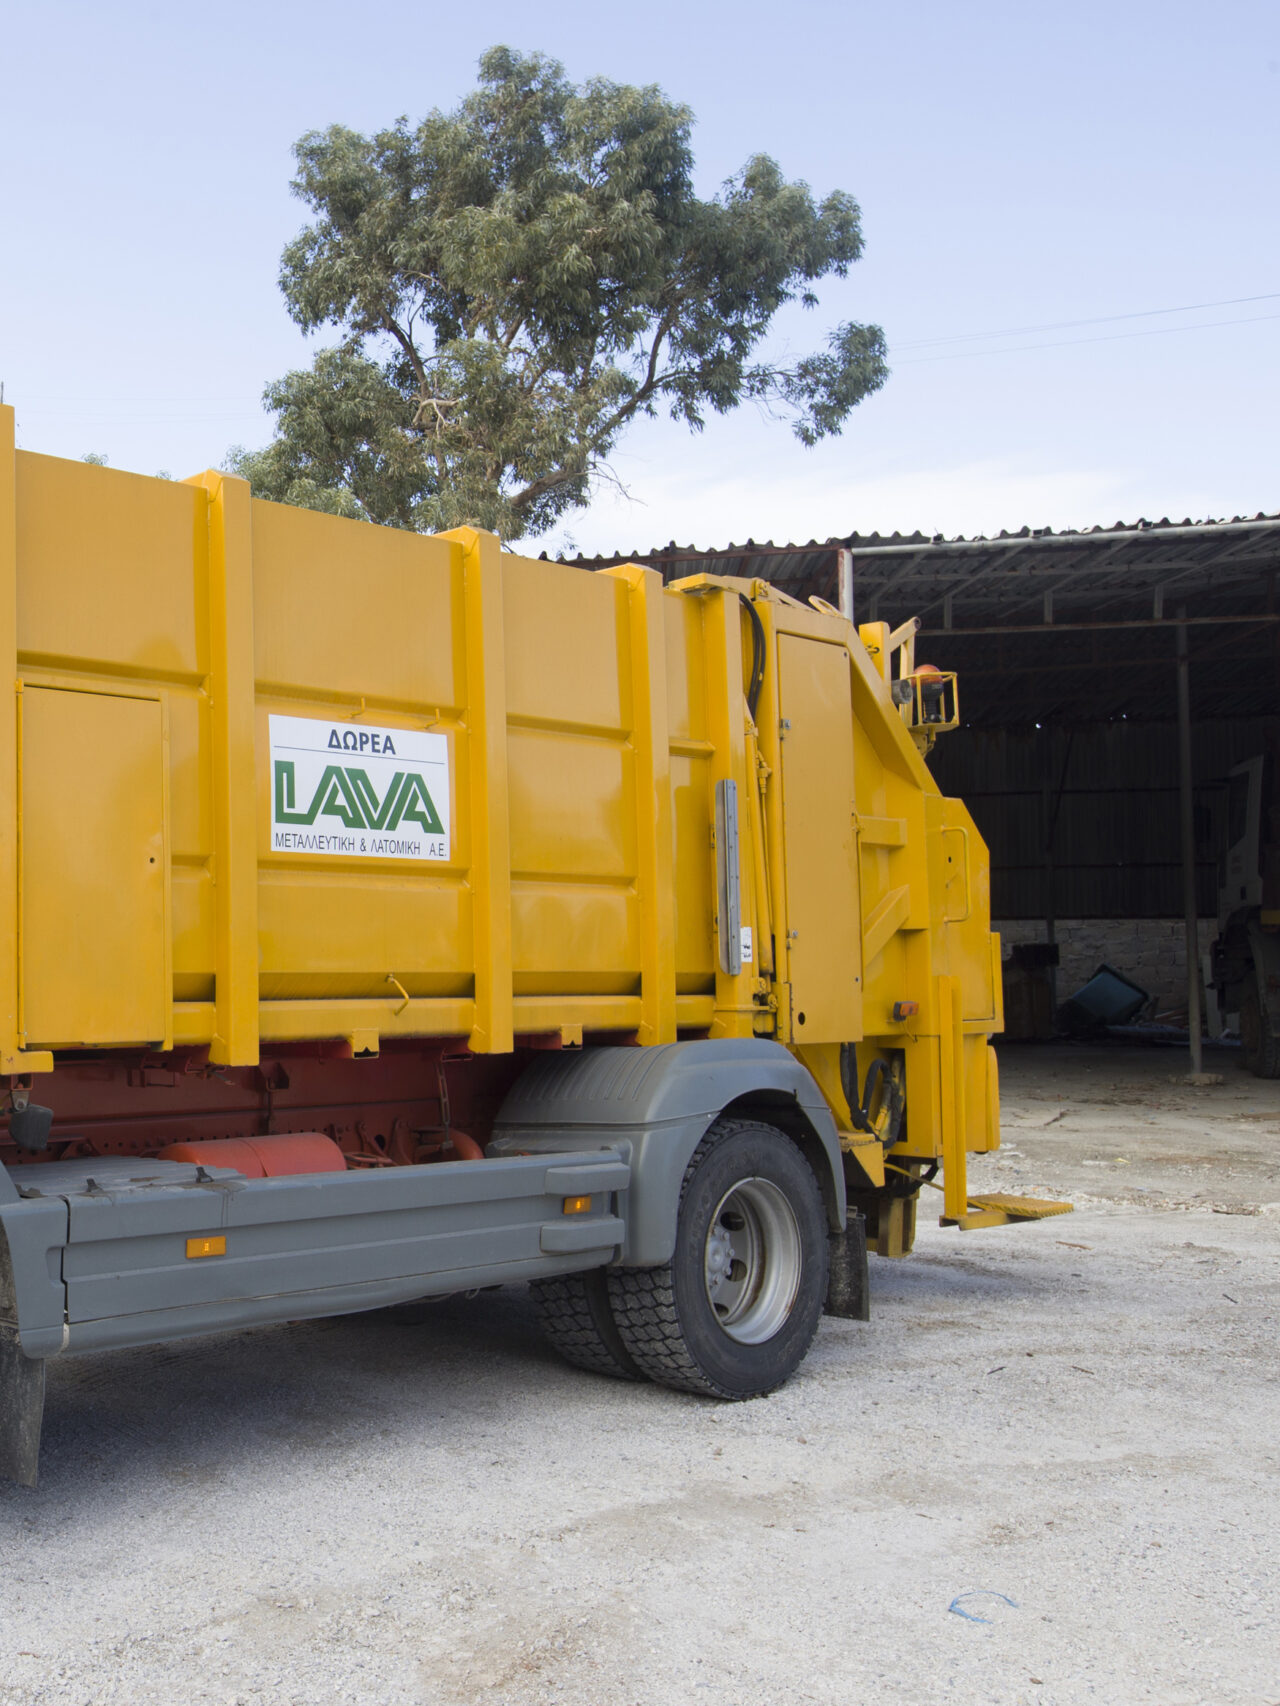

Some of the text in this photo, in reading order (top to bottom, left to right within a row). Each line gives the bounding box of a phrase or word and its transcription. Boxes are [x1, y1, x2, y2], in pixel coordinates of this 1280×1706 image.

[327, 728, 397, 756] ΔΩΡΕΑ
[274, 759, 446, 835] LAVA
[275, 832, 355, 851] ΜΕΤΑΛΛΕΥΤΙΚΗ
[359, 838, 367, 852] &
[370, 838, 421, 855] ΛΑΤΟΜΙΚΗ
